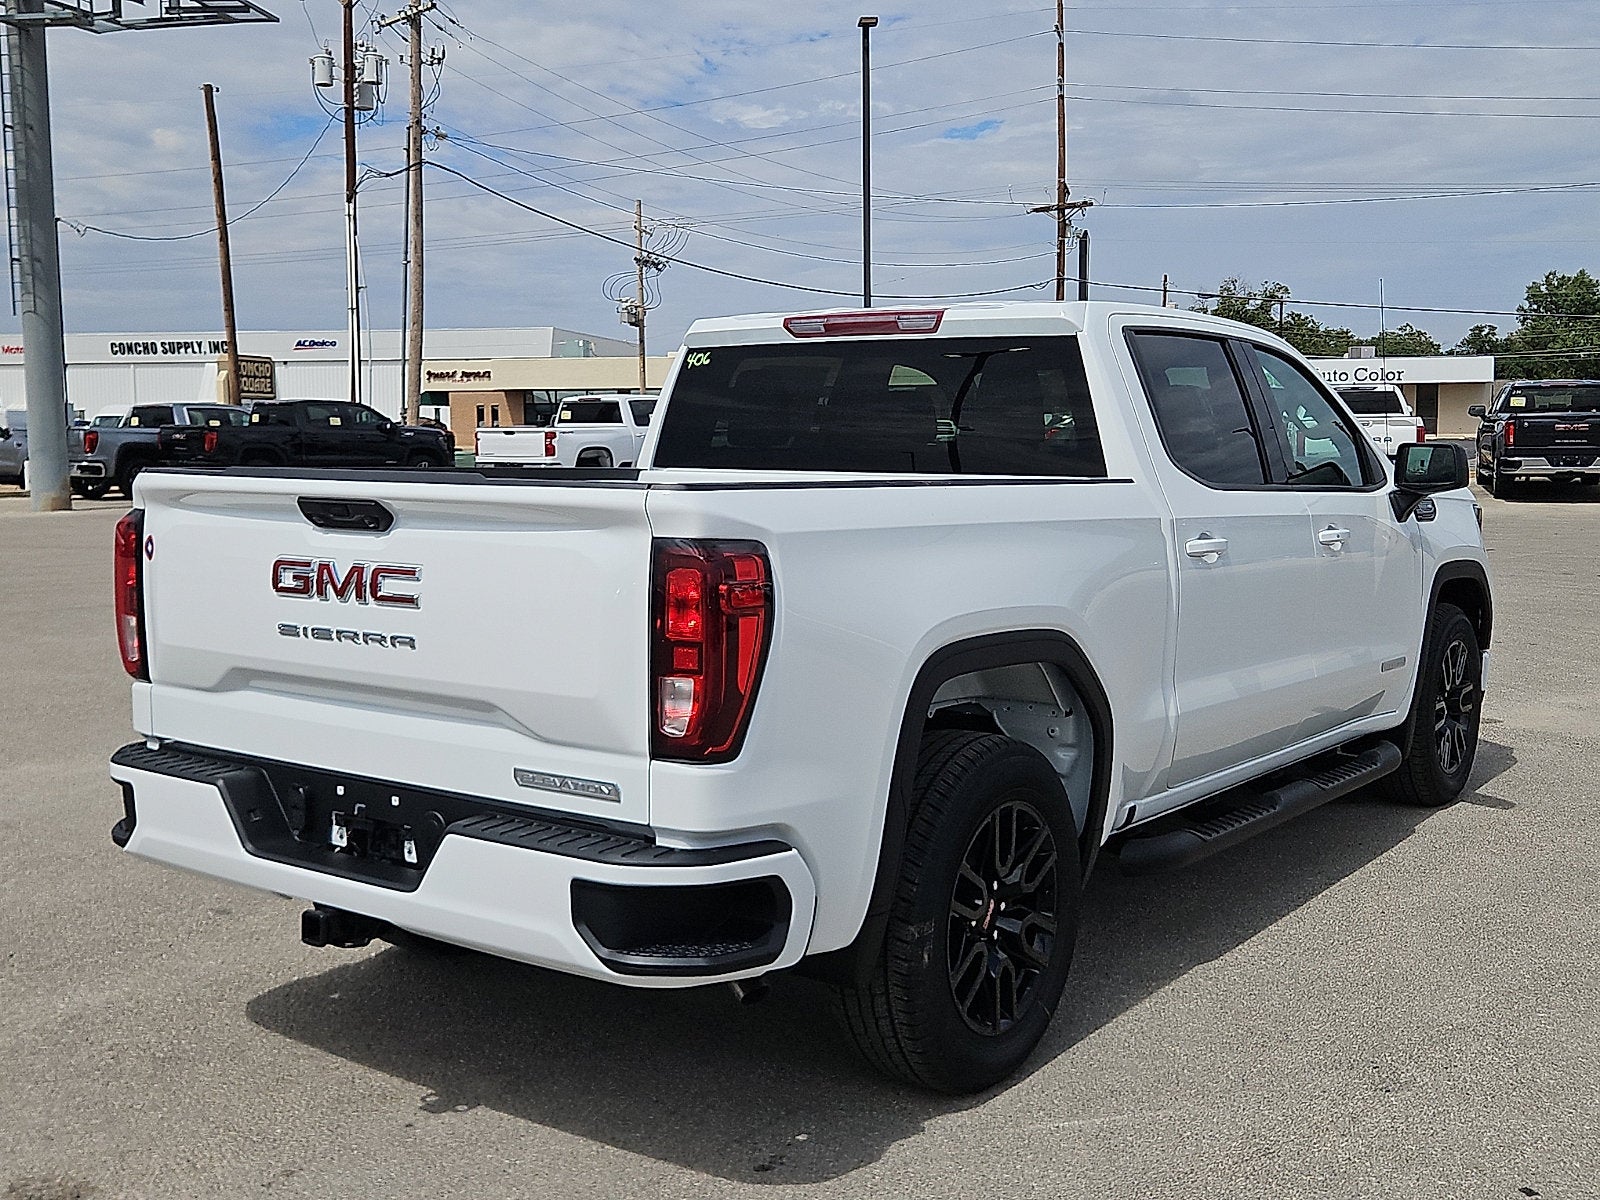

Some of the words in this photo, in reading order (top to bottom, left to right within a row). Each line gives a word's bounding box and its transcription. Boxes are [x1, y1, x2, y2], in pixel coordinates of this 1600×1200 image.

[110, 341, 158, 355] CONCHO
[161, 340, 207, 355] SUPPLY,
[294, 339, 337, 348] ACDelco
[239, 361, 271, 376] ONCHO
[687, 351, 711, 370] 406
[1353, 367, 1404, 382] Color
[272, 554, 422, 610] GMC
[277, 622, 418, 650] SIERRA
[518, 771, 616, 797] ELEVATION
